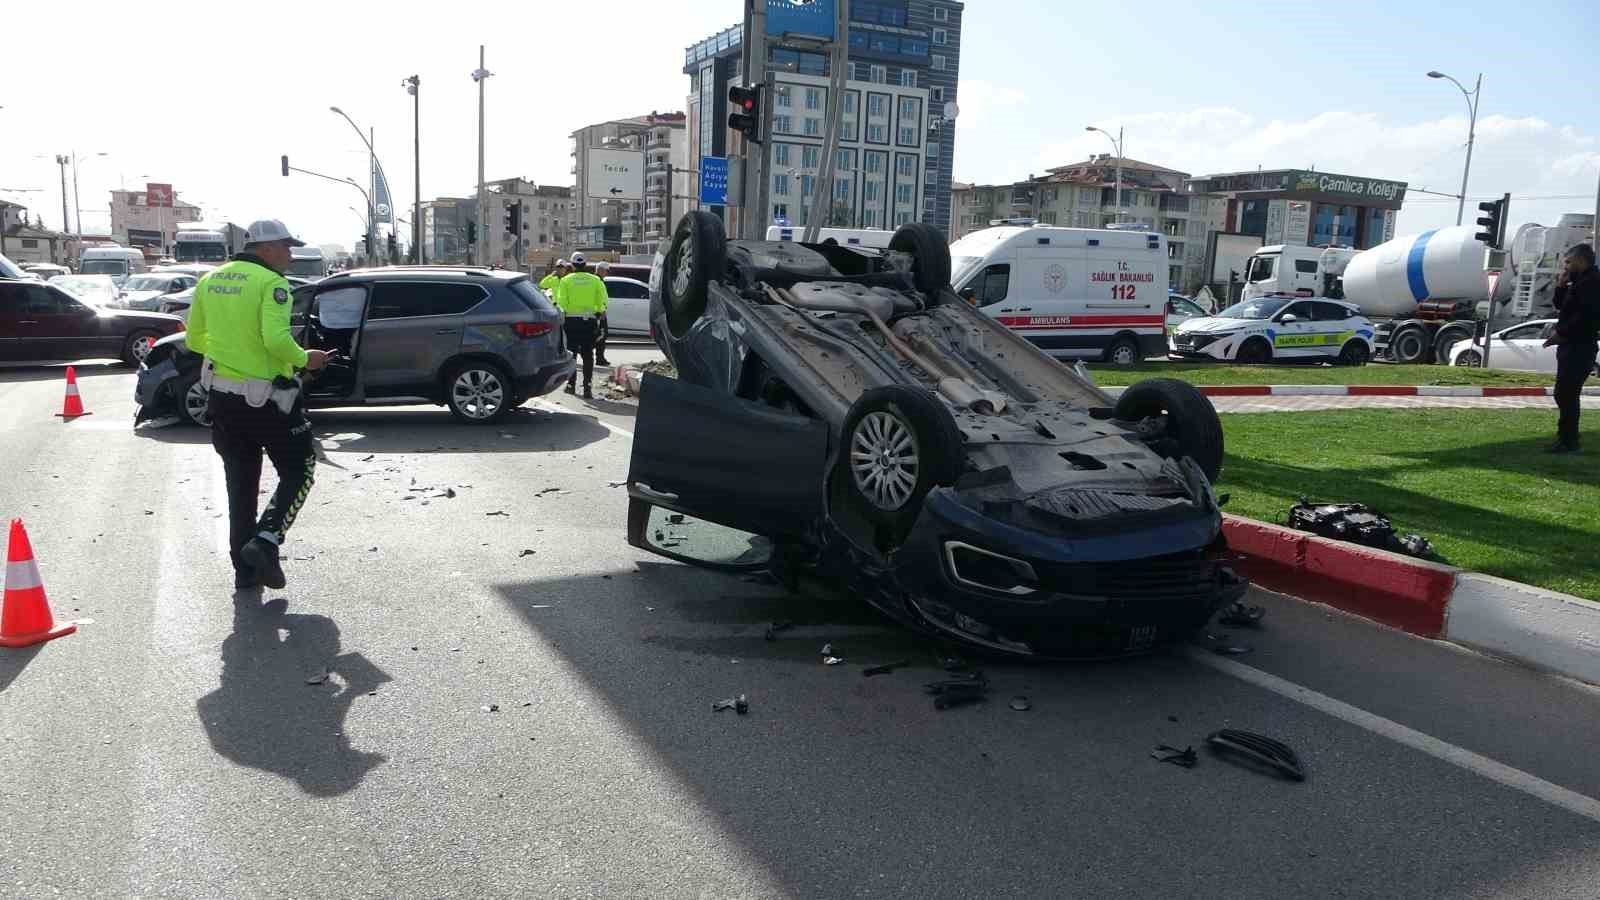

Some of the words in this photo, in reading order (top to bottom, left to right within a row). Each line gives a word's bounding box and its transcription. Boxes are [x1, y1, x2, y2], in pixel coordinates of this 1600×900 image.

[603, 163, 629, 173] Tecde
[1319, 175, 1364, 193] Çamlıca
[1091, 271, 1116, 282] SAĞLIK
[1119, 270, 1154, 283] BAKANLIĞI
[1111, 284, 1136, 300] 112
[1029, 315, 1071, 326] AMBULANS
